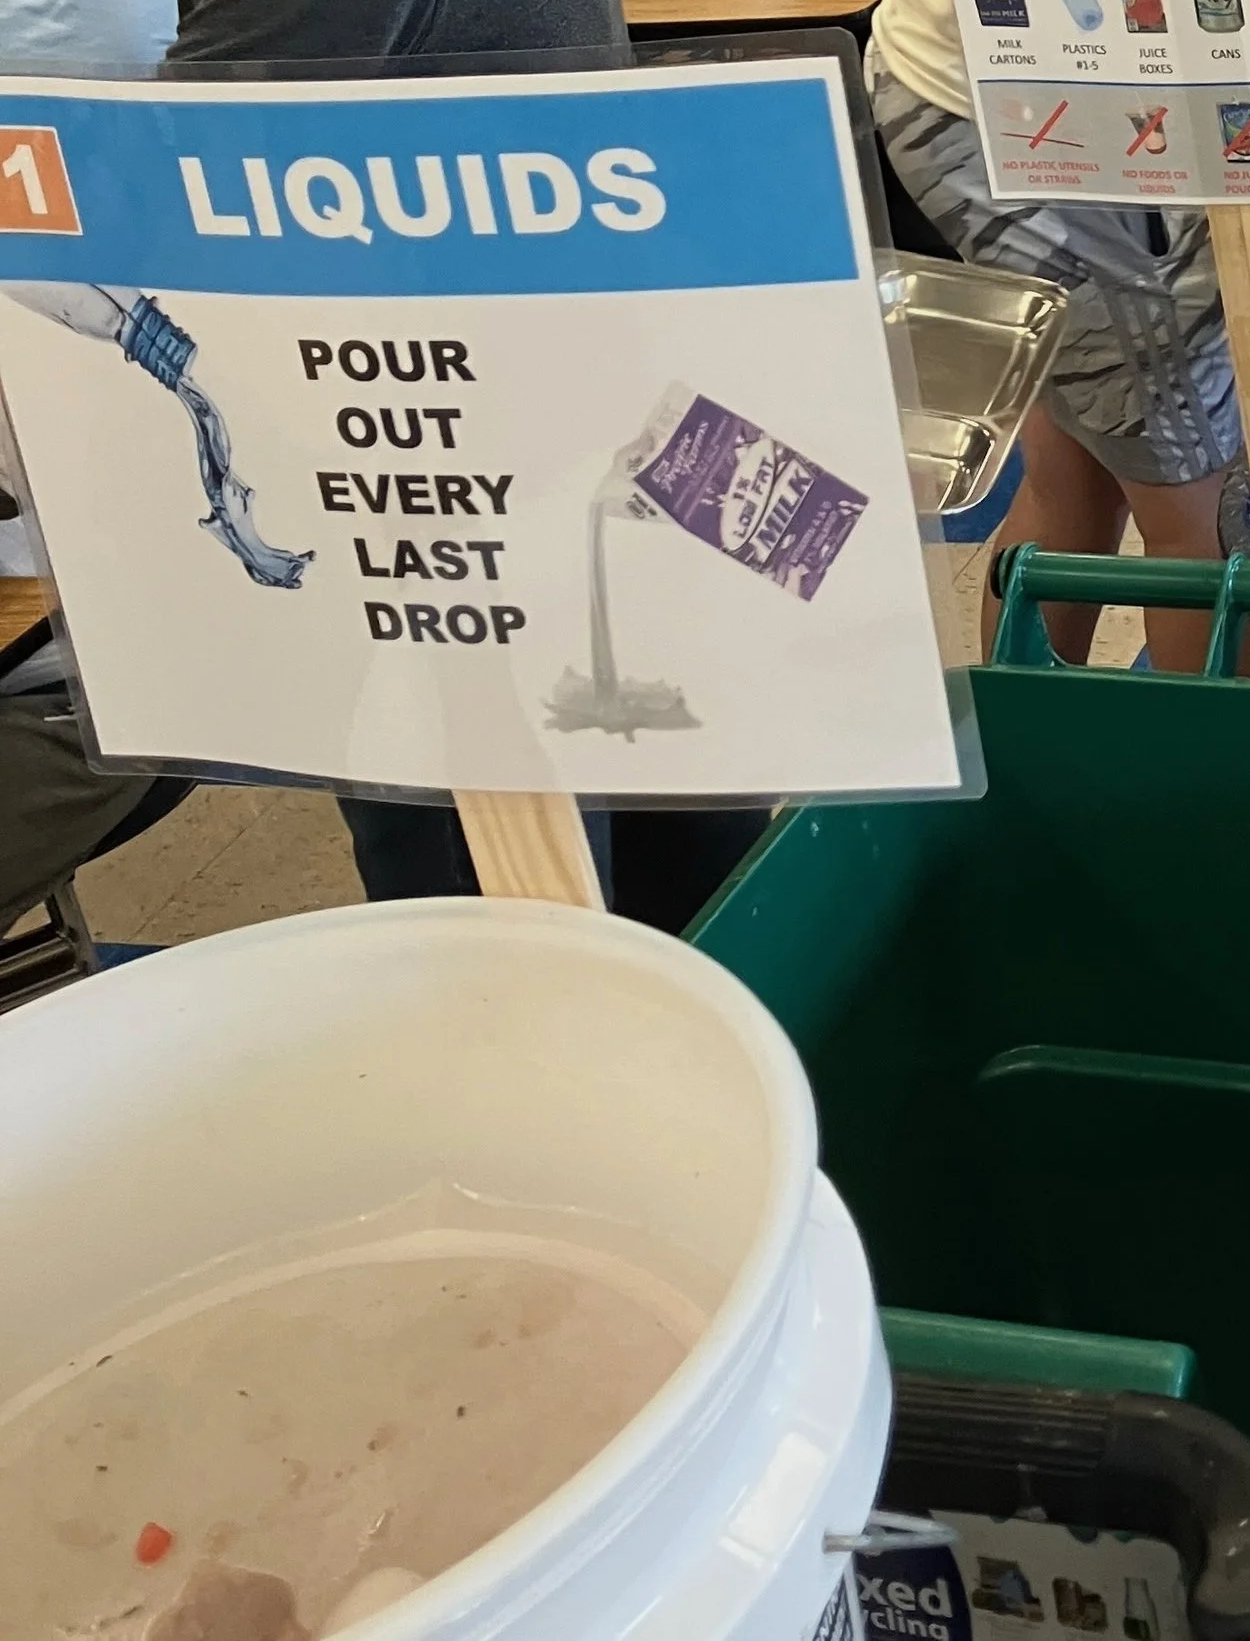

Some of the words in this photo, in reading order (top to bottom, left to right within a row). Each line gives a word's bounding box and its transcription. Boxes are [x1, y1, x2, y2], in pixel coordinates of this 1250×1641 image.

[997, 39, 1023, 50] MILK
[1062, 44, 1107, 55] PLASTICS
[1139, 47, 1167, 58] JUICE
[1211, 48, 1241, 59] CANS
[989, 54, 1037, 66] CARTONS
[1076, 60, 1099, 70] #1-5
[1139, 64, 1173, 74] BOXES
[1002, 161, 1019, 171] NO
[1020, 160, 1058, 171] PLASTIC
[1059, 162, 1100, 173] UTENSILS
[1122, 170, 1137, 179] NO
[1139, 169, 1173, 180] FOODS
[1223, 170, 1240, 180] NO
[2, 143, 48, 215] 1
[178, 146, 669, 246] LIQUIDS
[1139, 184, 1176, 194] LIQUIDS
[297, 338, 478, 384] POUR
[335, 407, 462, 450] OUT
[315, 471, 515, 517] EVERY
[733, 500, 758, 539] LOW
[751, 457, 775, 496] FAT
[755, 468, 815, 550] MILK
[353, 538, 507, 581] LAST
[364, 600, 527, 645] DROP
[856, 1574, 953, 1618] xed
